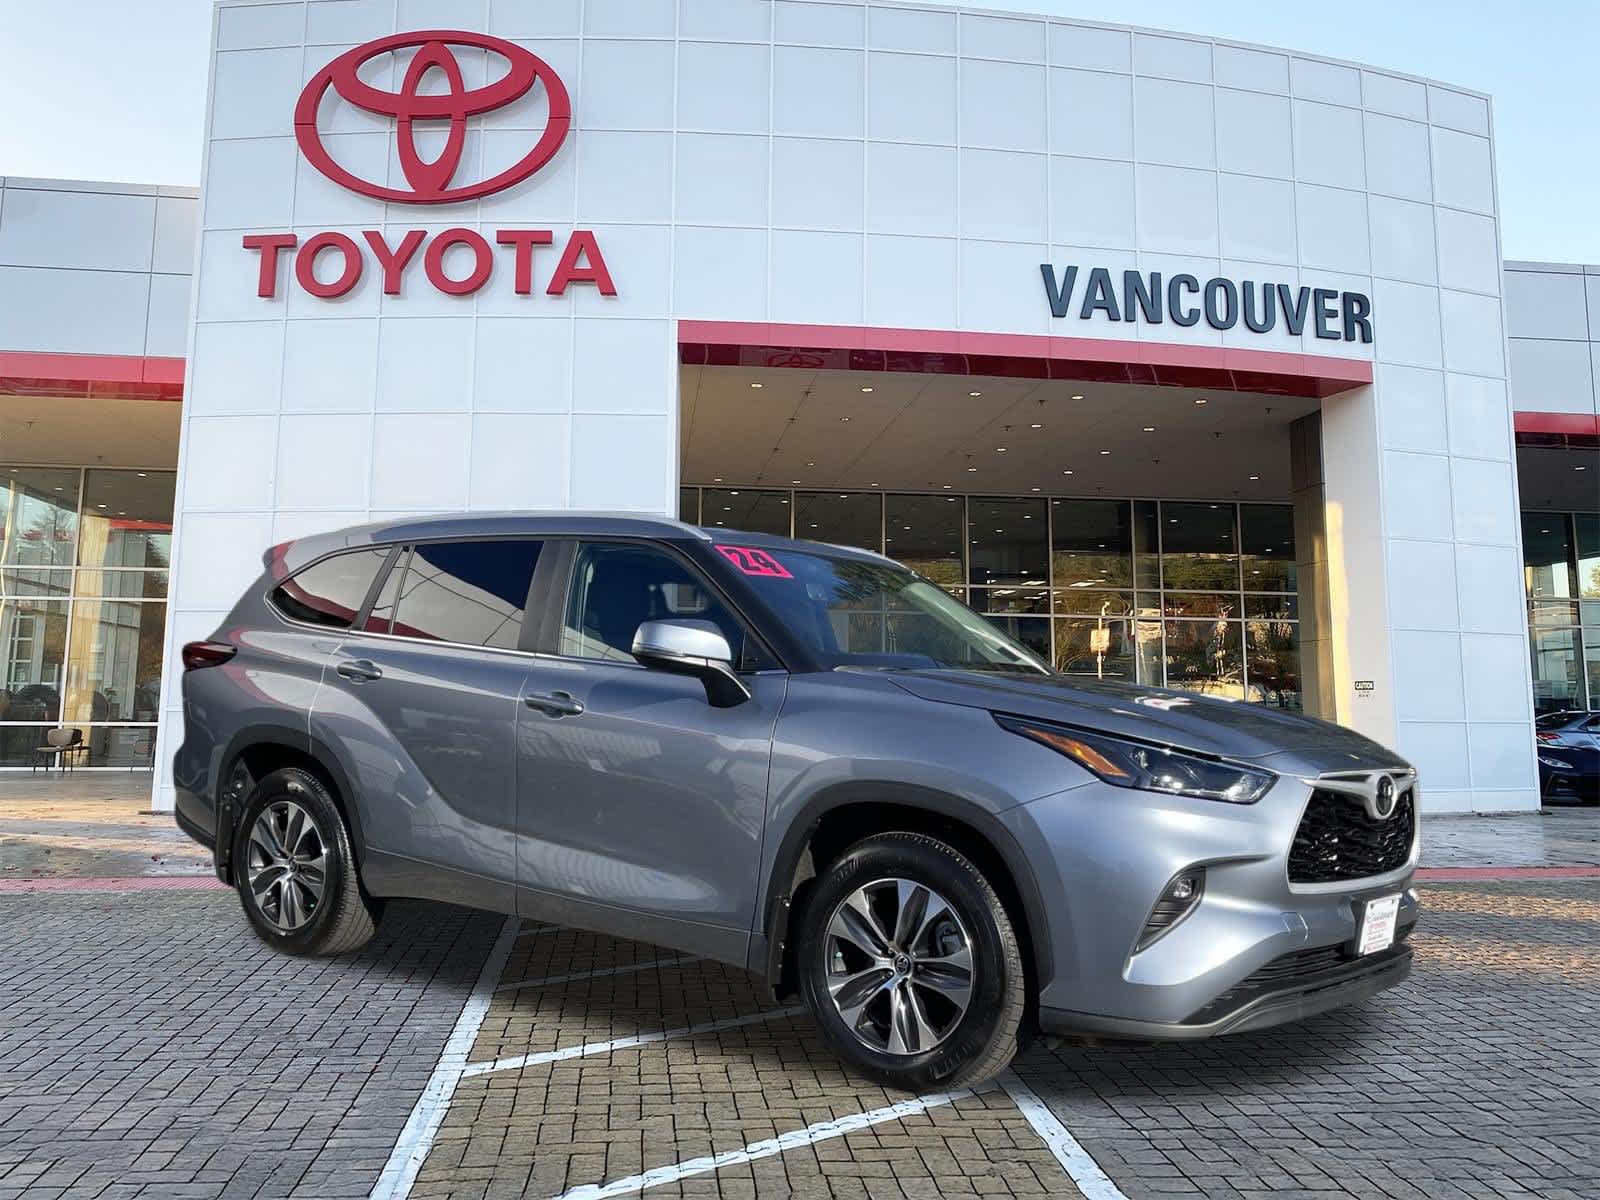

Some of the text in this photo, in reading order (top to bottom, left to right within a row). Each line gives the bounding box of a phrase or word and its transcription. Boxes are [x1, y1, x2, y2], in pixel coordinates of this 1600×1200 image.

[242, 227, 618, 299] TOYOTA
[1040, 264, 1373, 343] VANCOUVER
[722, 548, 783, 575] 24
